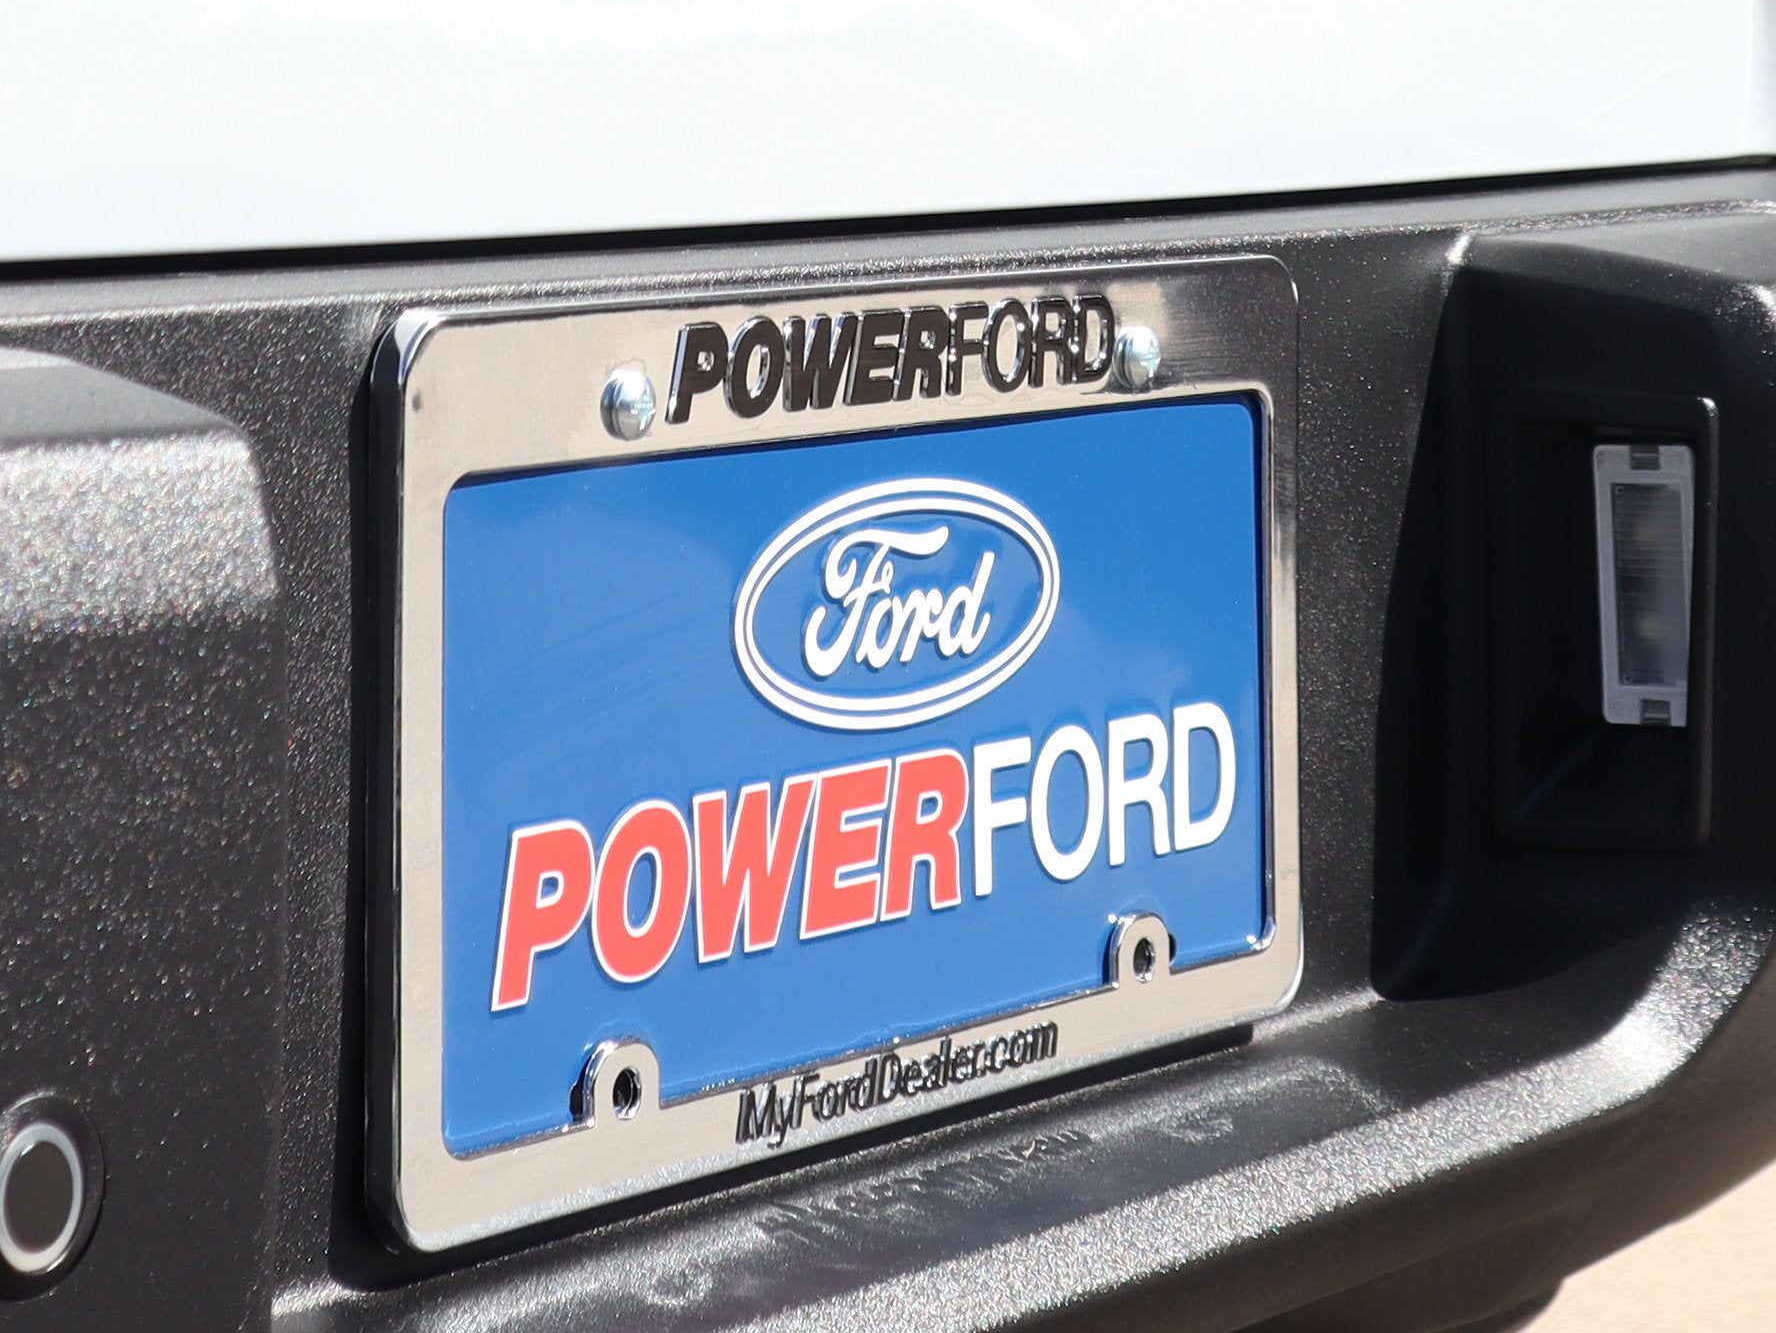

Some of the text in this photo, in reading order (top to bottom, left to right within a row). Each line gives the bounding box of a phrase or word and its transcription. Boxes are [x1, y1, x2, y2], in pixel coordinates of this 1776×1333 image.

[664, 294, 1117, 425] POWERFORD
[802, 523, 997, 678] Ford
[489, 700, 1237, 1013] POWERFORD
[734, 1019, 1060, 1149] MyFordDealer.com
